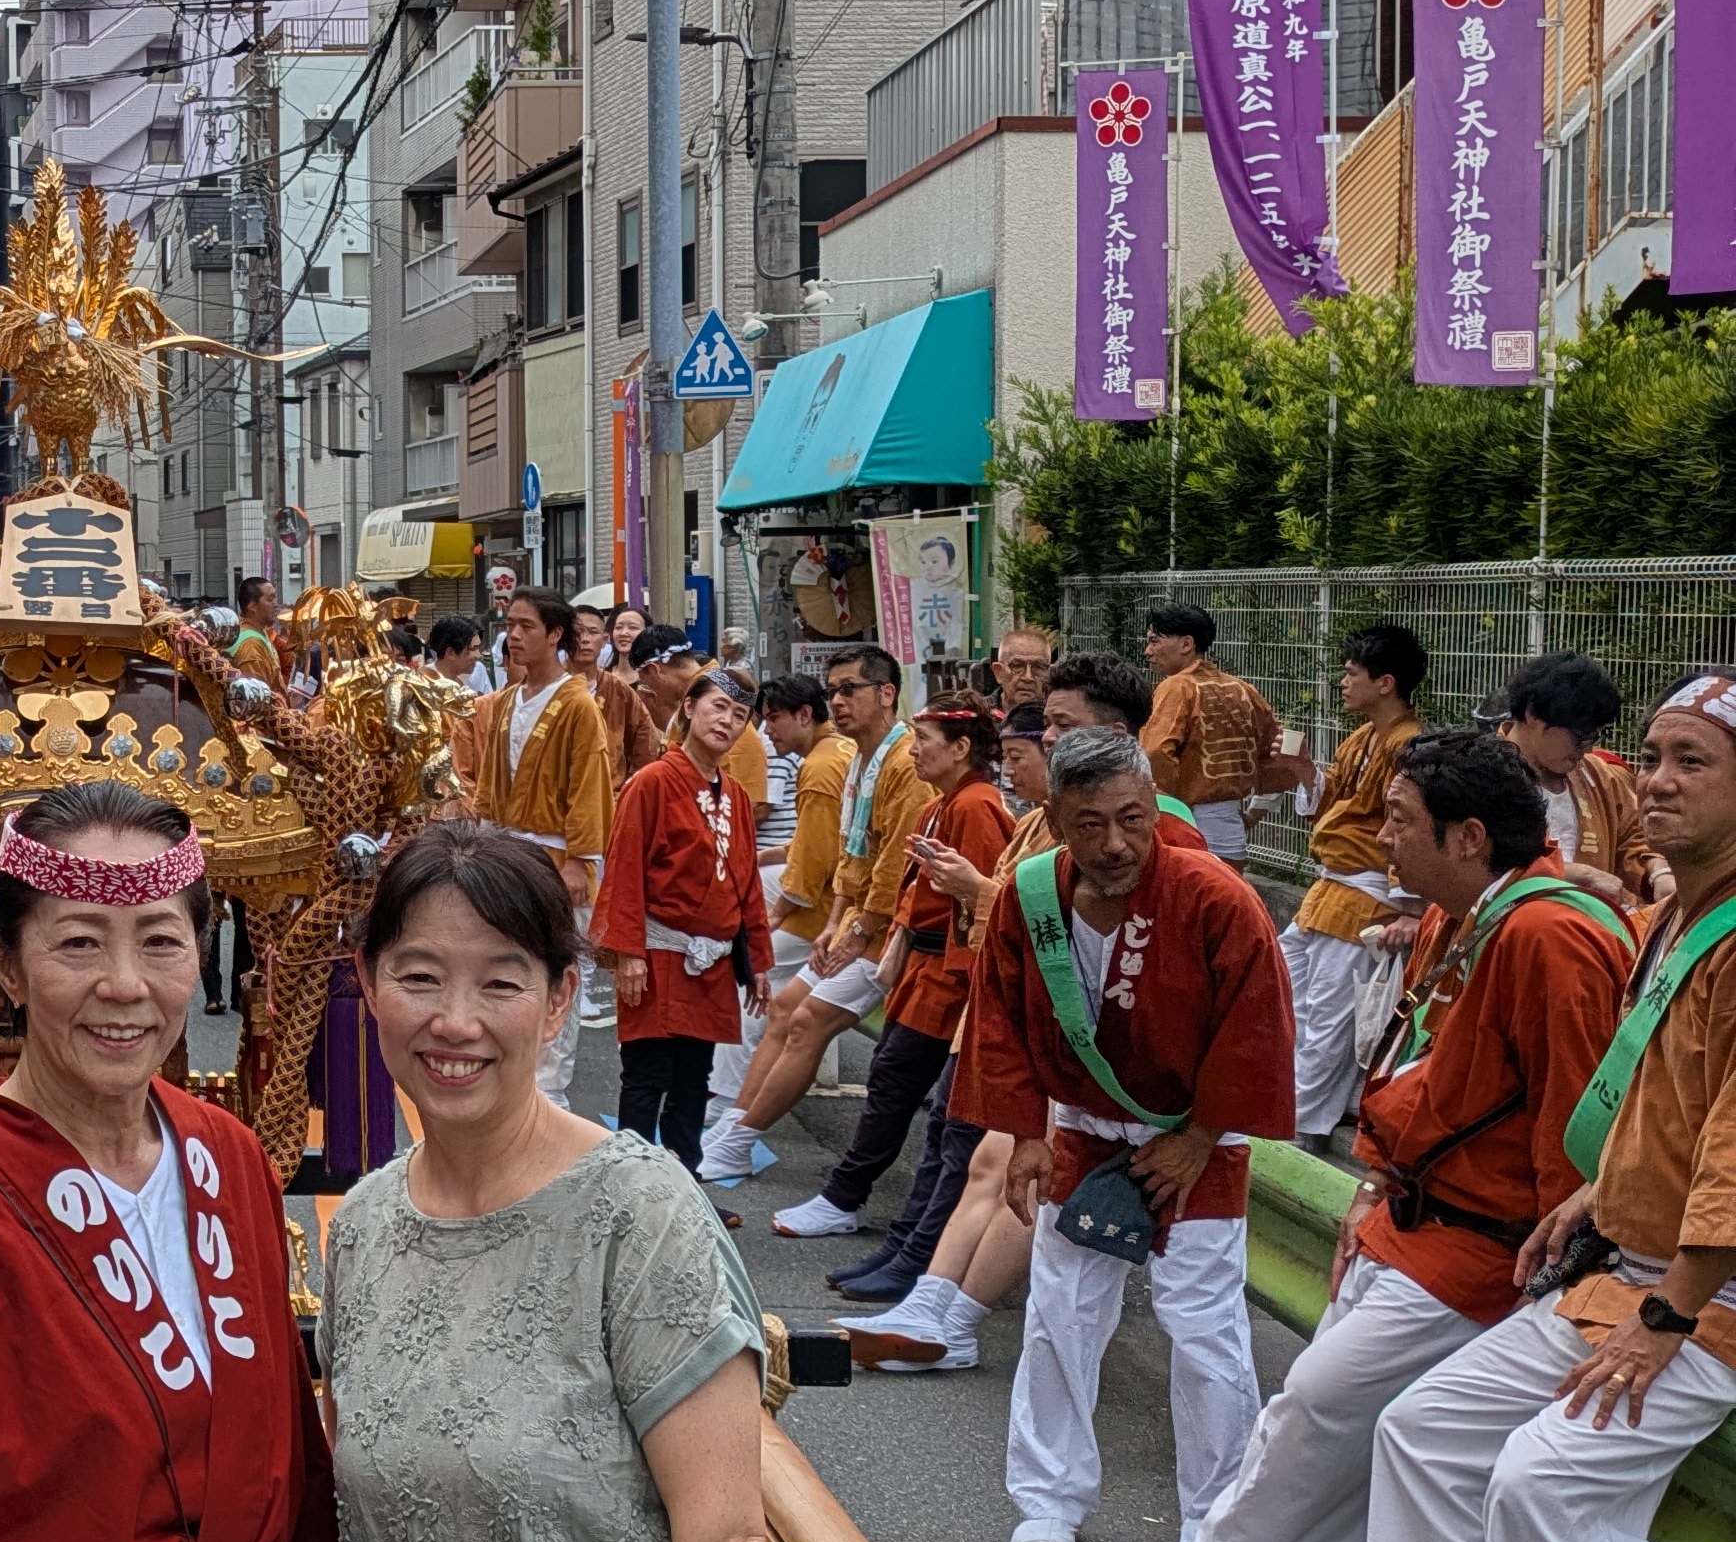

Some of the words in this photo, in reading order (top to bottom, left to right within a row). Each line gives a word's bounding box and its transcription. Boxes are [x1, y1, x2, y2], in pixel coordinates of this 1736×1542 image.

[1102, 152, 1137, 394] 亀戸天神社御祭禮
[1447, 16, 1498, 351] 亀戸天神社御祭禮
[47, 1168, 195, 1391] のりこ
[186, 1137, 255, 1359] のりこ
